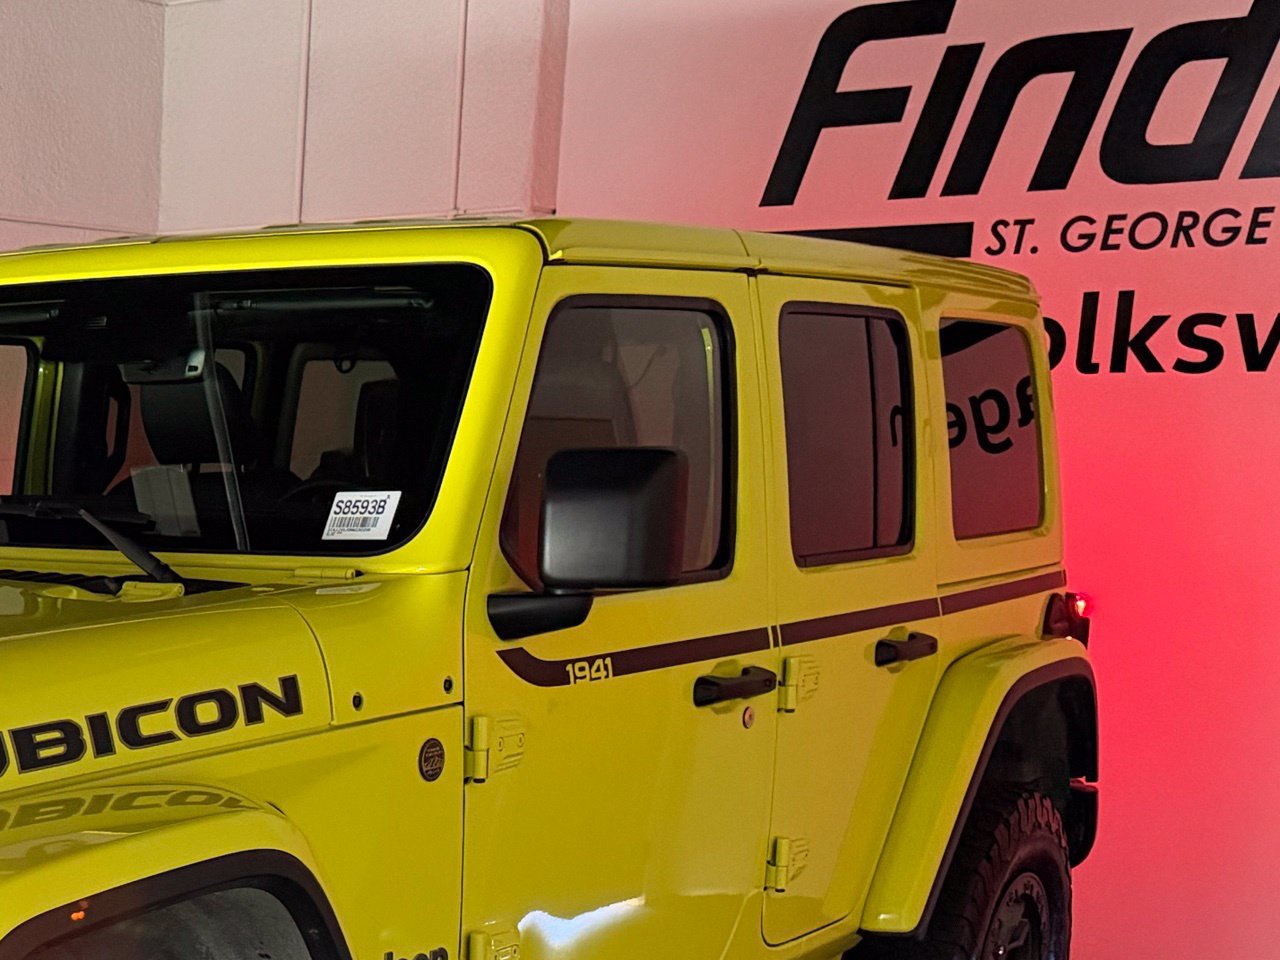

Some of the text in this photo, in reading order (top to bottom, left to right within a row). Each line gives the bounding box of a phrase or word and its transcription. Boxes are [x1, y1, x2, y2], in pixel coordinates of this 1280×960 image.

[984, 206, 1276, 256] ST. GEORGE
[333, 499, 387, 515] S8593B
[565, 657, 613, 686] 1941
